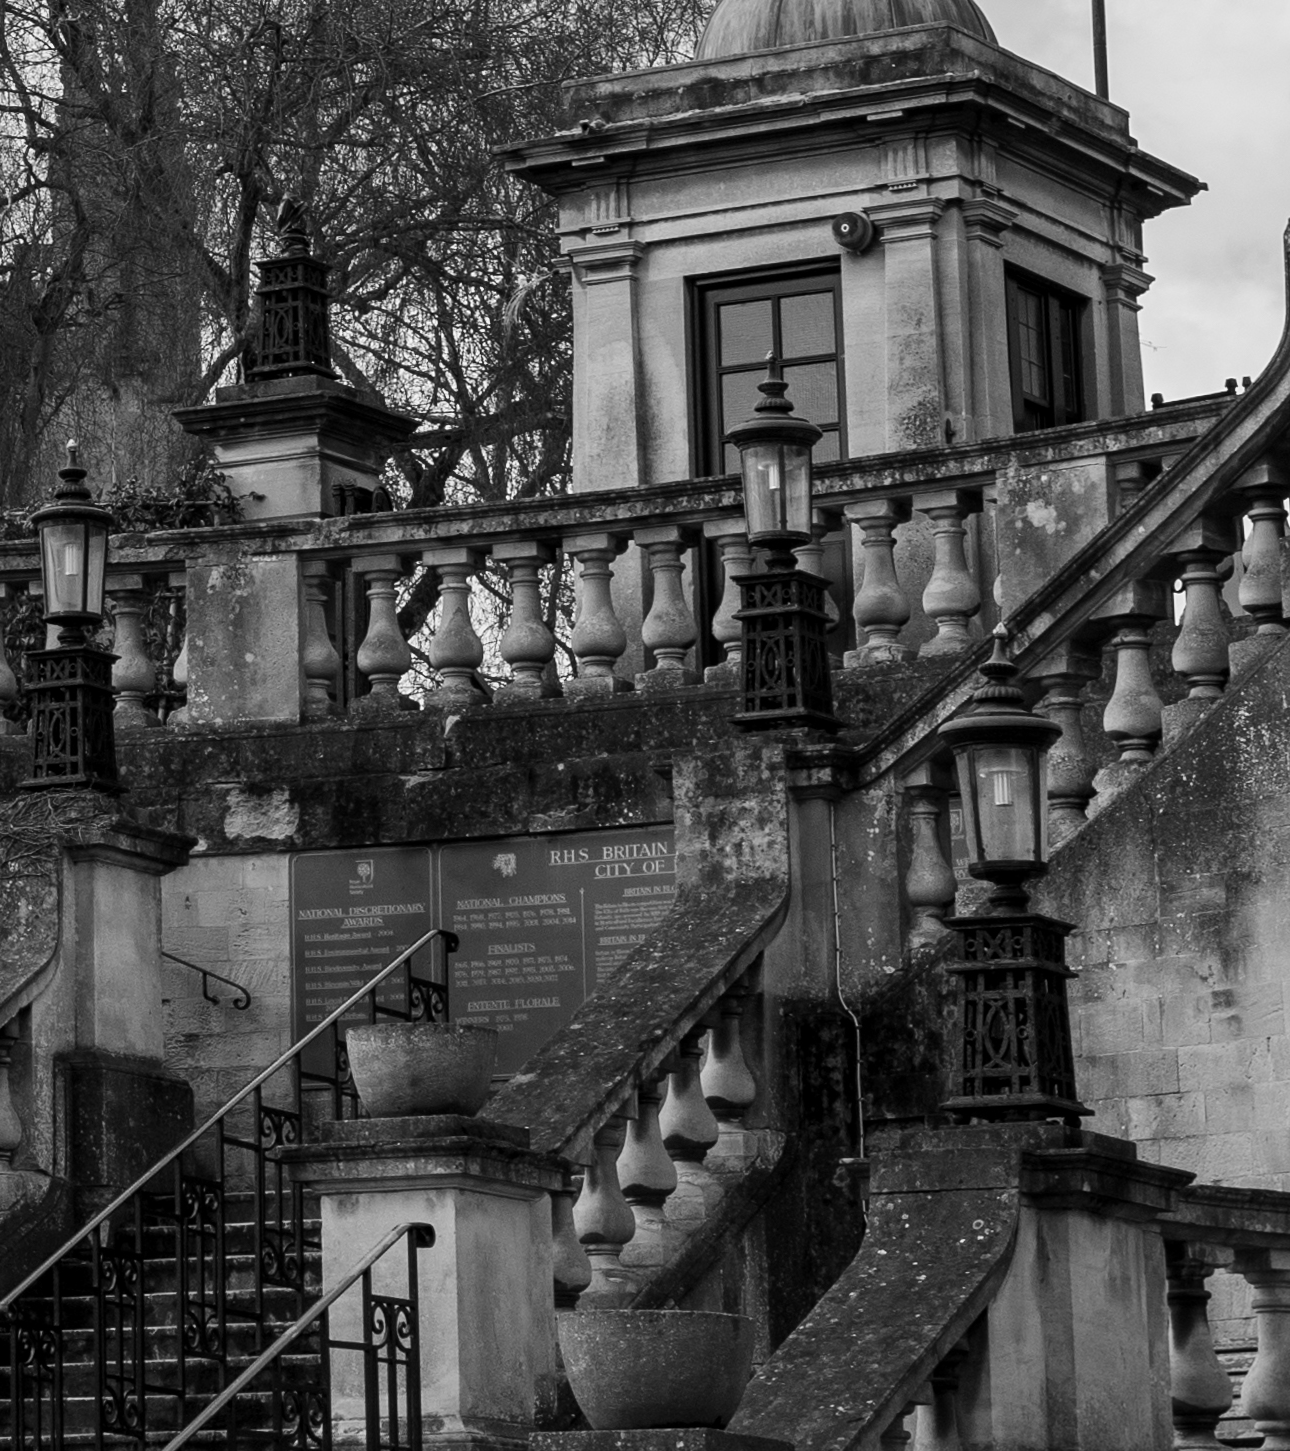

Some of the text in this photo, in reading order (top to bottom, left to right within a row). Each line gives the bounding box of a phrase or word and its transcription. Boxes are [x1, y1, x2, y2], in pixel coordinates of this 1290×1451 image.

[602, 842, 668, 860] BRITAIN
[595, 860, 665, 877] CITY OF
[457, 893, 566, 908] NATIONAL CHAMPIONS
[298, 903, 425, 918] NATIONAL DISCRETIONARY
[343, 916, 384, 926] AWARDS
[488, 943, 536, 953] FINALISTS
[468, 997, 560, 1010] ENTENTE FLORALE
